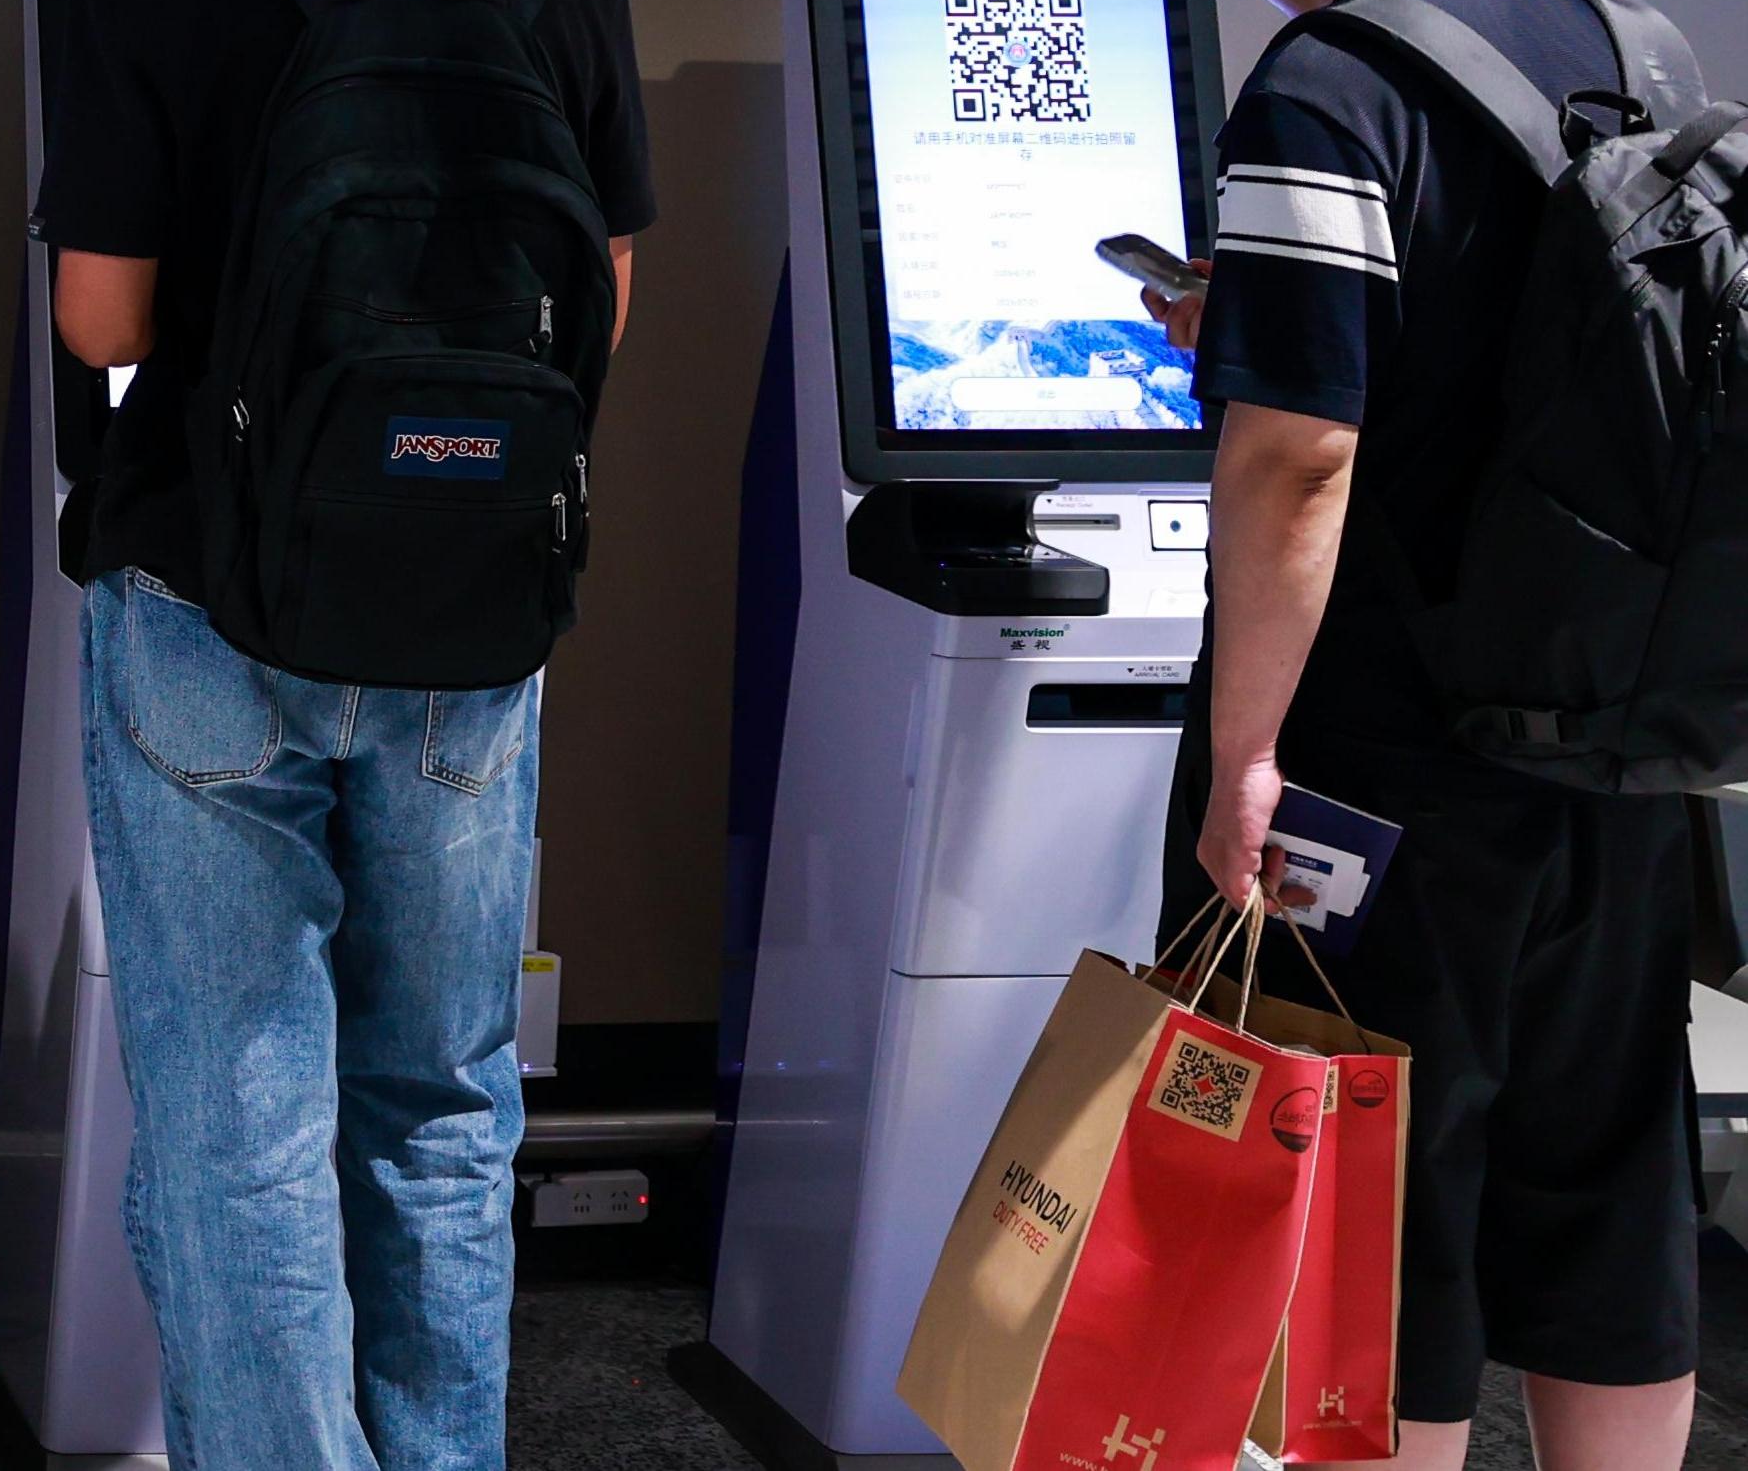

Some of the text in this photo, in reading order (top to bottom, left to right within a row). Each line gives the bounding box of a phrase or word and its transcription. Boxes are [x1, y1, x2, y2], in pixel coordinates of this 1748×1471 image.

[391, 434, 501, 462] JANSPORT
[1000, 627, 1065, 638] Maxvision
[1000, 1160, 1078, 1235] HYUNDAI
[992, 1200, 1049, 1256] DUTY FREE
